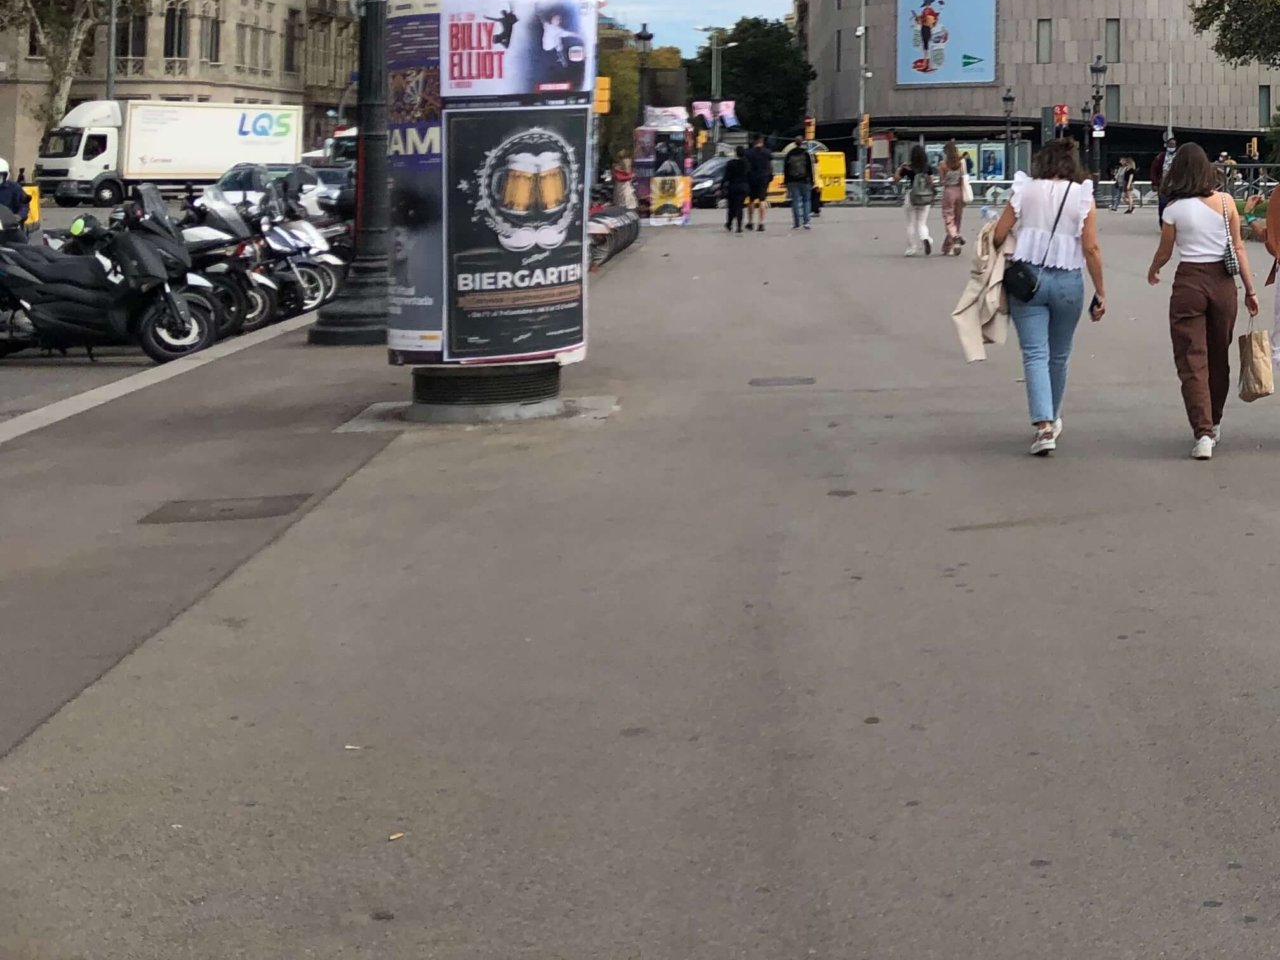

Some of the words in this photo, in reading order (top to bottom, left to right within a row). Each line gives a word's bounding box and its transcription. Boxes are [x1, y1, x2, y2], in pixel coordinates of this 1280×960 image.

[450, 22, 495, 50] BILLY
[450, 51, 505, 80] ELLIOT
[238, 112, 293, 136] LQS
[386, 126, 441, 156] AM
[457, 263, 582, 291] BIERGARTEN
